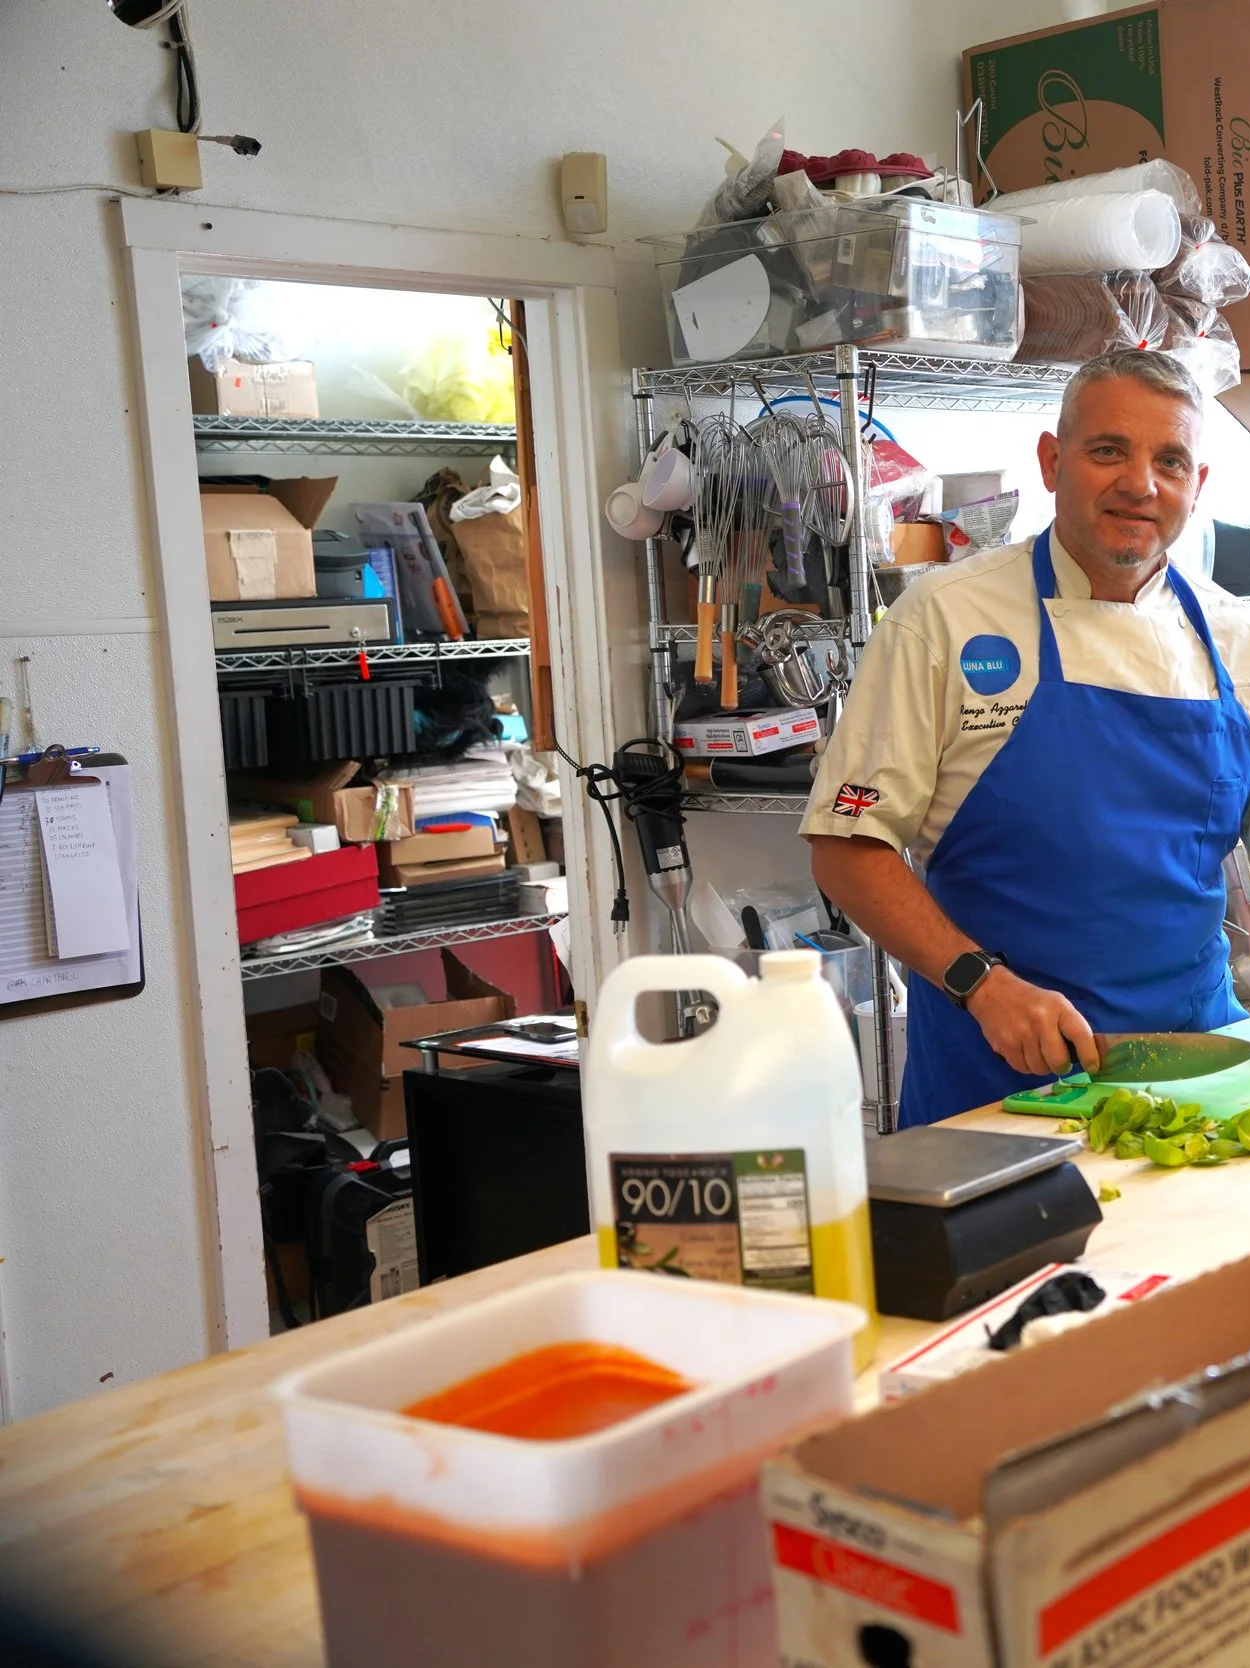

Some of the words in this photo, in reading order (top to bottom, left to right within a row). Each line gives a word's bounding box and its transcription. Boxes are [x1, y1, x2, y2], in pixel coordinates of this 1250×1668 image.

[988, 58, 996, 78] 200
[989, 80, 997, 110] Count
[1213, 77, 1223, 123] WestRock
[1215, 124, 1225, 176] Converting
[1203, 156, 1213, 216] fold-pak.com
[1218, 177, 1227, 220] Company
[1233, 171, 1245, 197] Plus
[1233, 199, 1245, 244] EARTH
[986, 661, 1003, 670] BLU
[961, 719, 1006, 731] Executive
[621, 1177, 732, 1217] 90/10
[1152, 1556, 1226, 1622] FOOD
